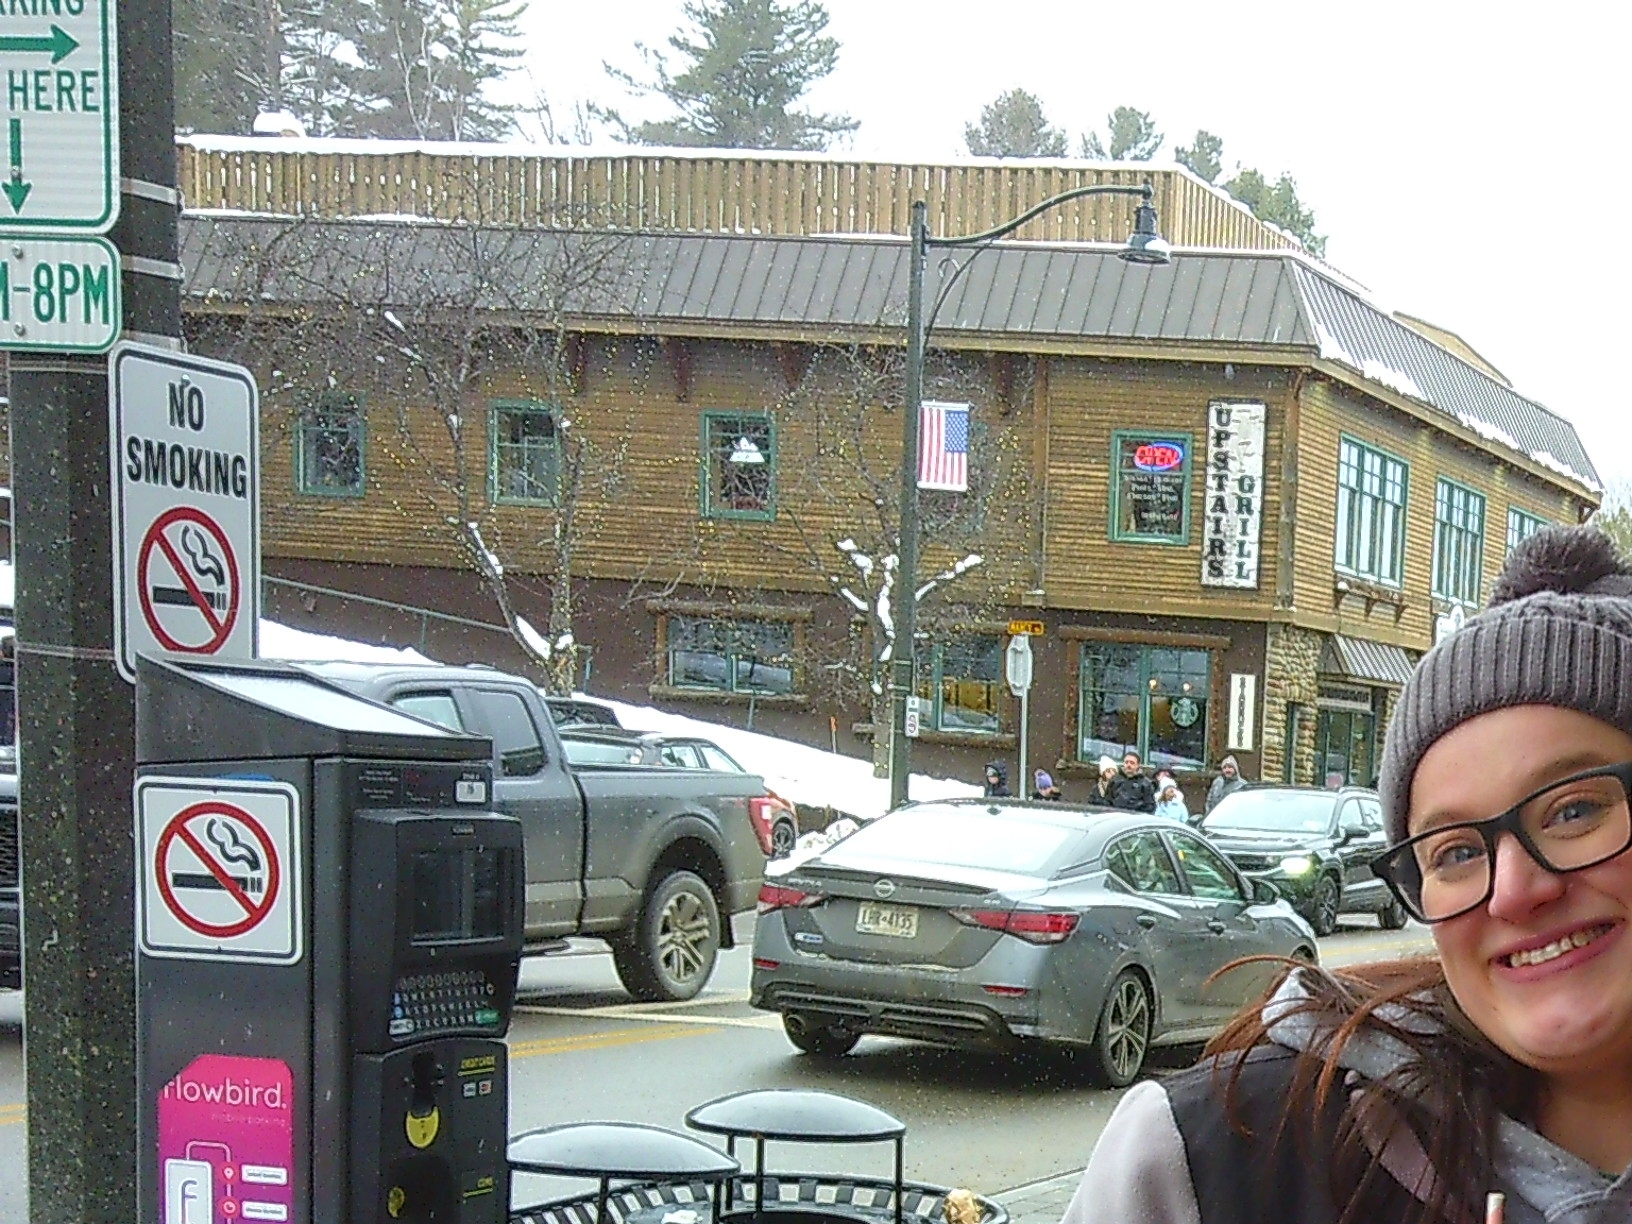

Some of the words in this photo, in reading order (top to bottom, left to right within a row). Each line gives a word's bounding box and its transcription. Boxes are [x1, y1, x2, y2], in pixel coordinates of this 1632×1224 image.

[8, 70, 99, 112] HERE
[168, 381, 204, 432] NO
[127, 435, 247, 499] SMOKING
[1208, 408, 1232, 578] UPSTAIRS
[1235, 475, 1256, 580] GRILL
